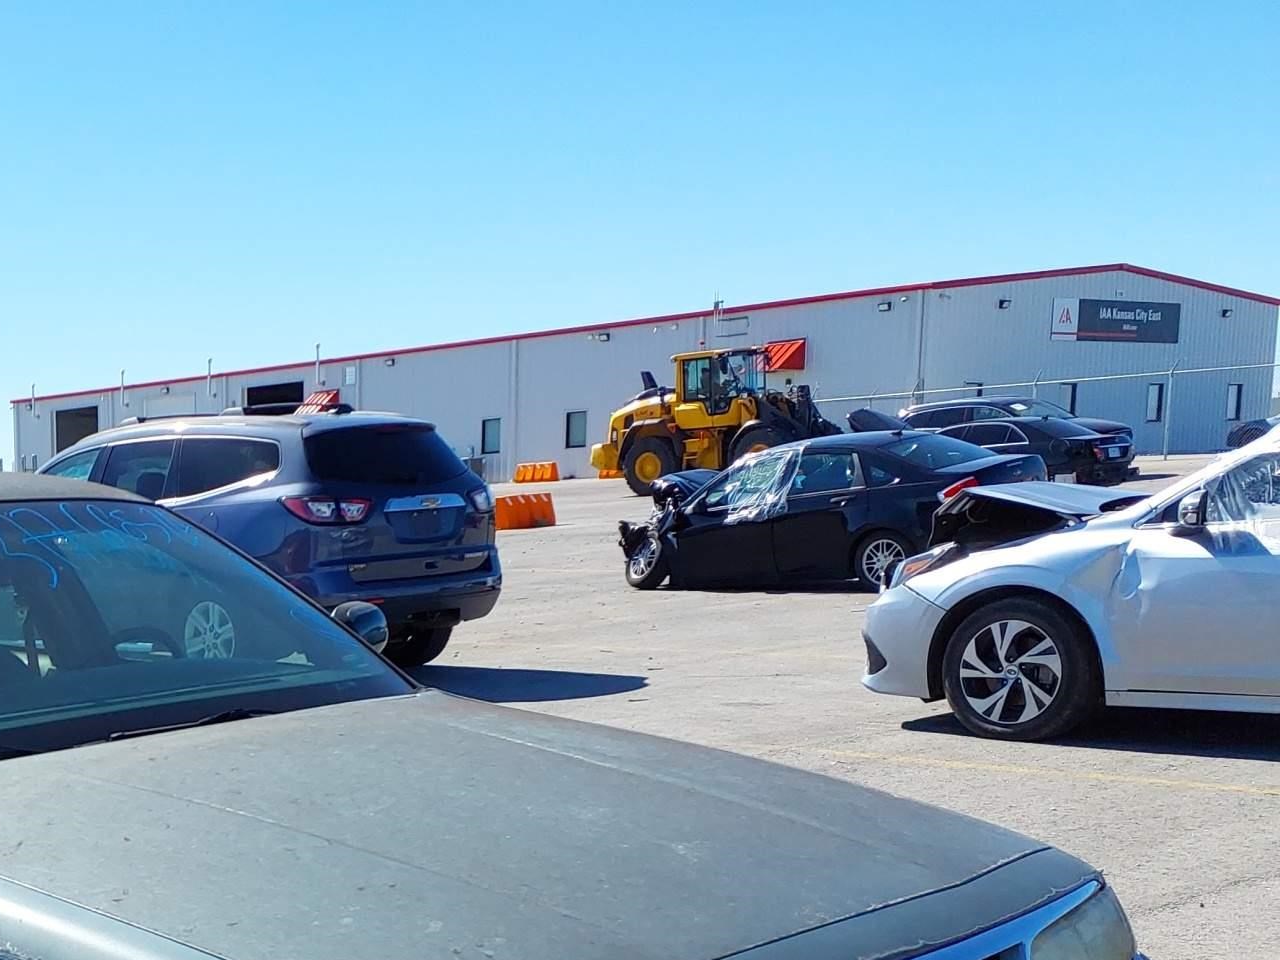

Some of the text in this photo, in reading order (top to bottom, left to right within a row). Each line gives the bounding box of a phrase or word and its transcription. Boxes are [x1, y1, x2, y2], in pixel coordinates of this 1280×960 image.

[1112, 308, 1135, 320] Kansas
[1135, 309, 1148, 323] City
[1148, 310, 1162, 321] East
